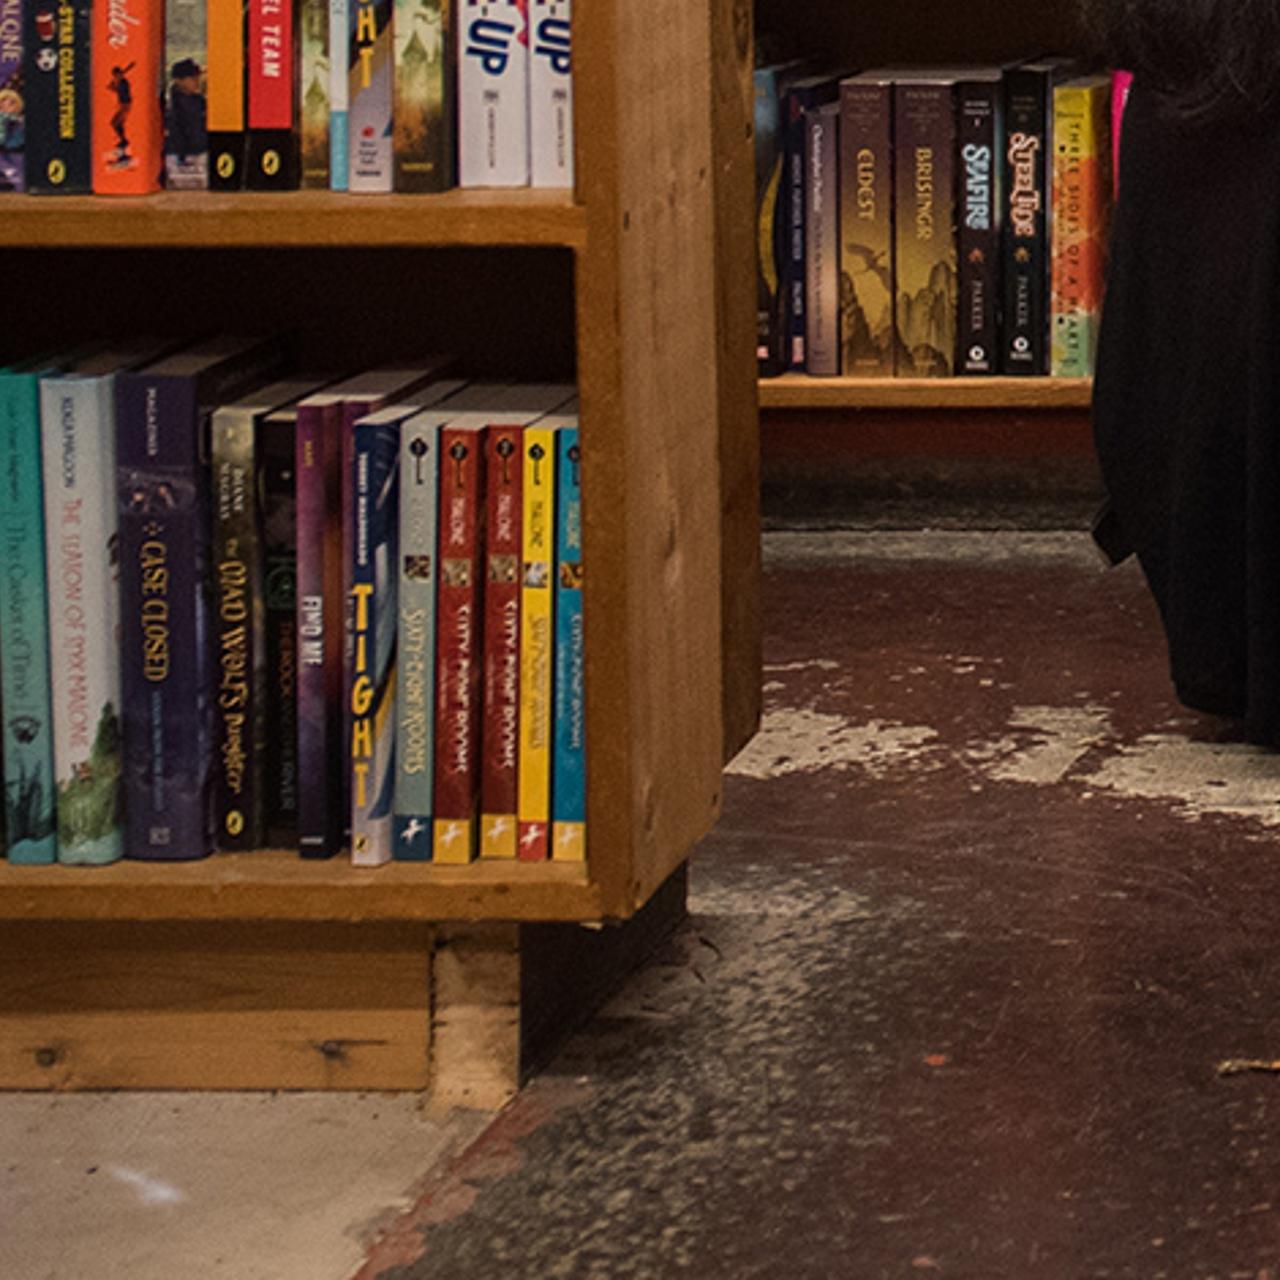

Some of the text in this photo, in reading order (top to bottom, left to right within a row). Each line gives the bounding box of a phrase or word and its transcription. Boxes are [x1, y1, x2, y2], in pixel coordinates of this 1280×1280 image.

[262, 28, 280, 79] TEAM
[915, 147, 932, 239] BRISINGR
[962, 144, 990, 230] SEAFIRE
[64, 499, 83, 523] THE
[65, 608, 82, 631] OF
[142, 542, 169, 683] CASE CLOSED
[302, 597, 322, 666] FIND ME
[68, 676, 87, 747] MALONE
